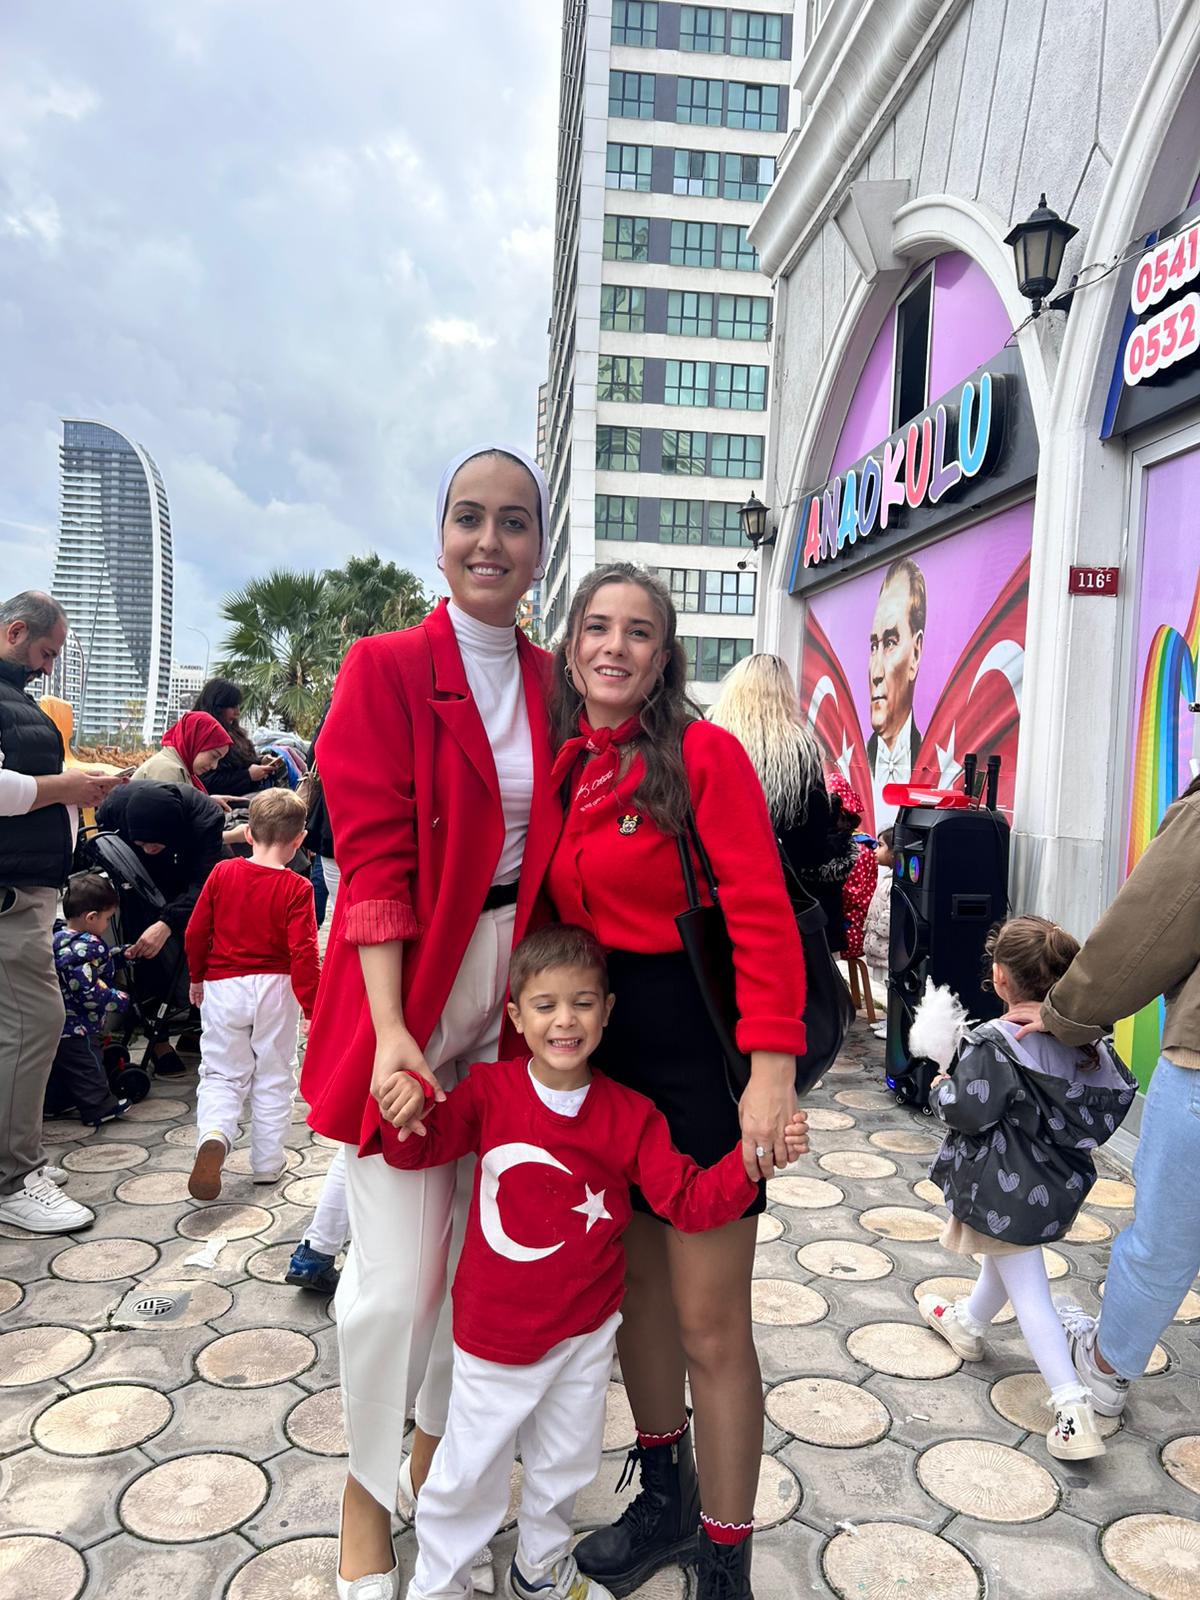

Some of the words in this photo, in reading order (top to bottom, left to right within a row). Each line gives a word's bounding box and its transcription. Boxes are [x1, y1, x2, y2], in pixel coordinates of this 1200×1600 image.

[1136, 227, 1199, 303] 0541
[1129, 303, 1196, 376] 0532
[804, 372, 992, 568] ANAOKULU
